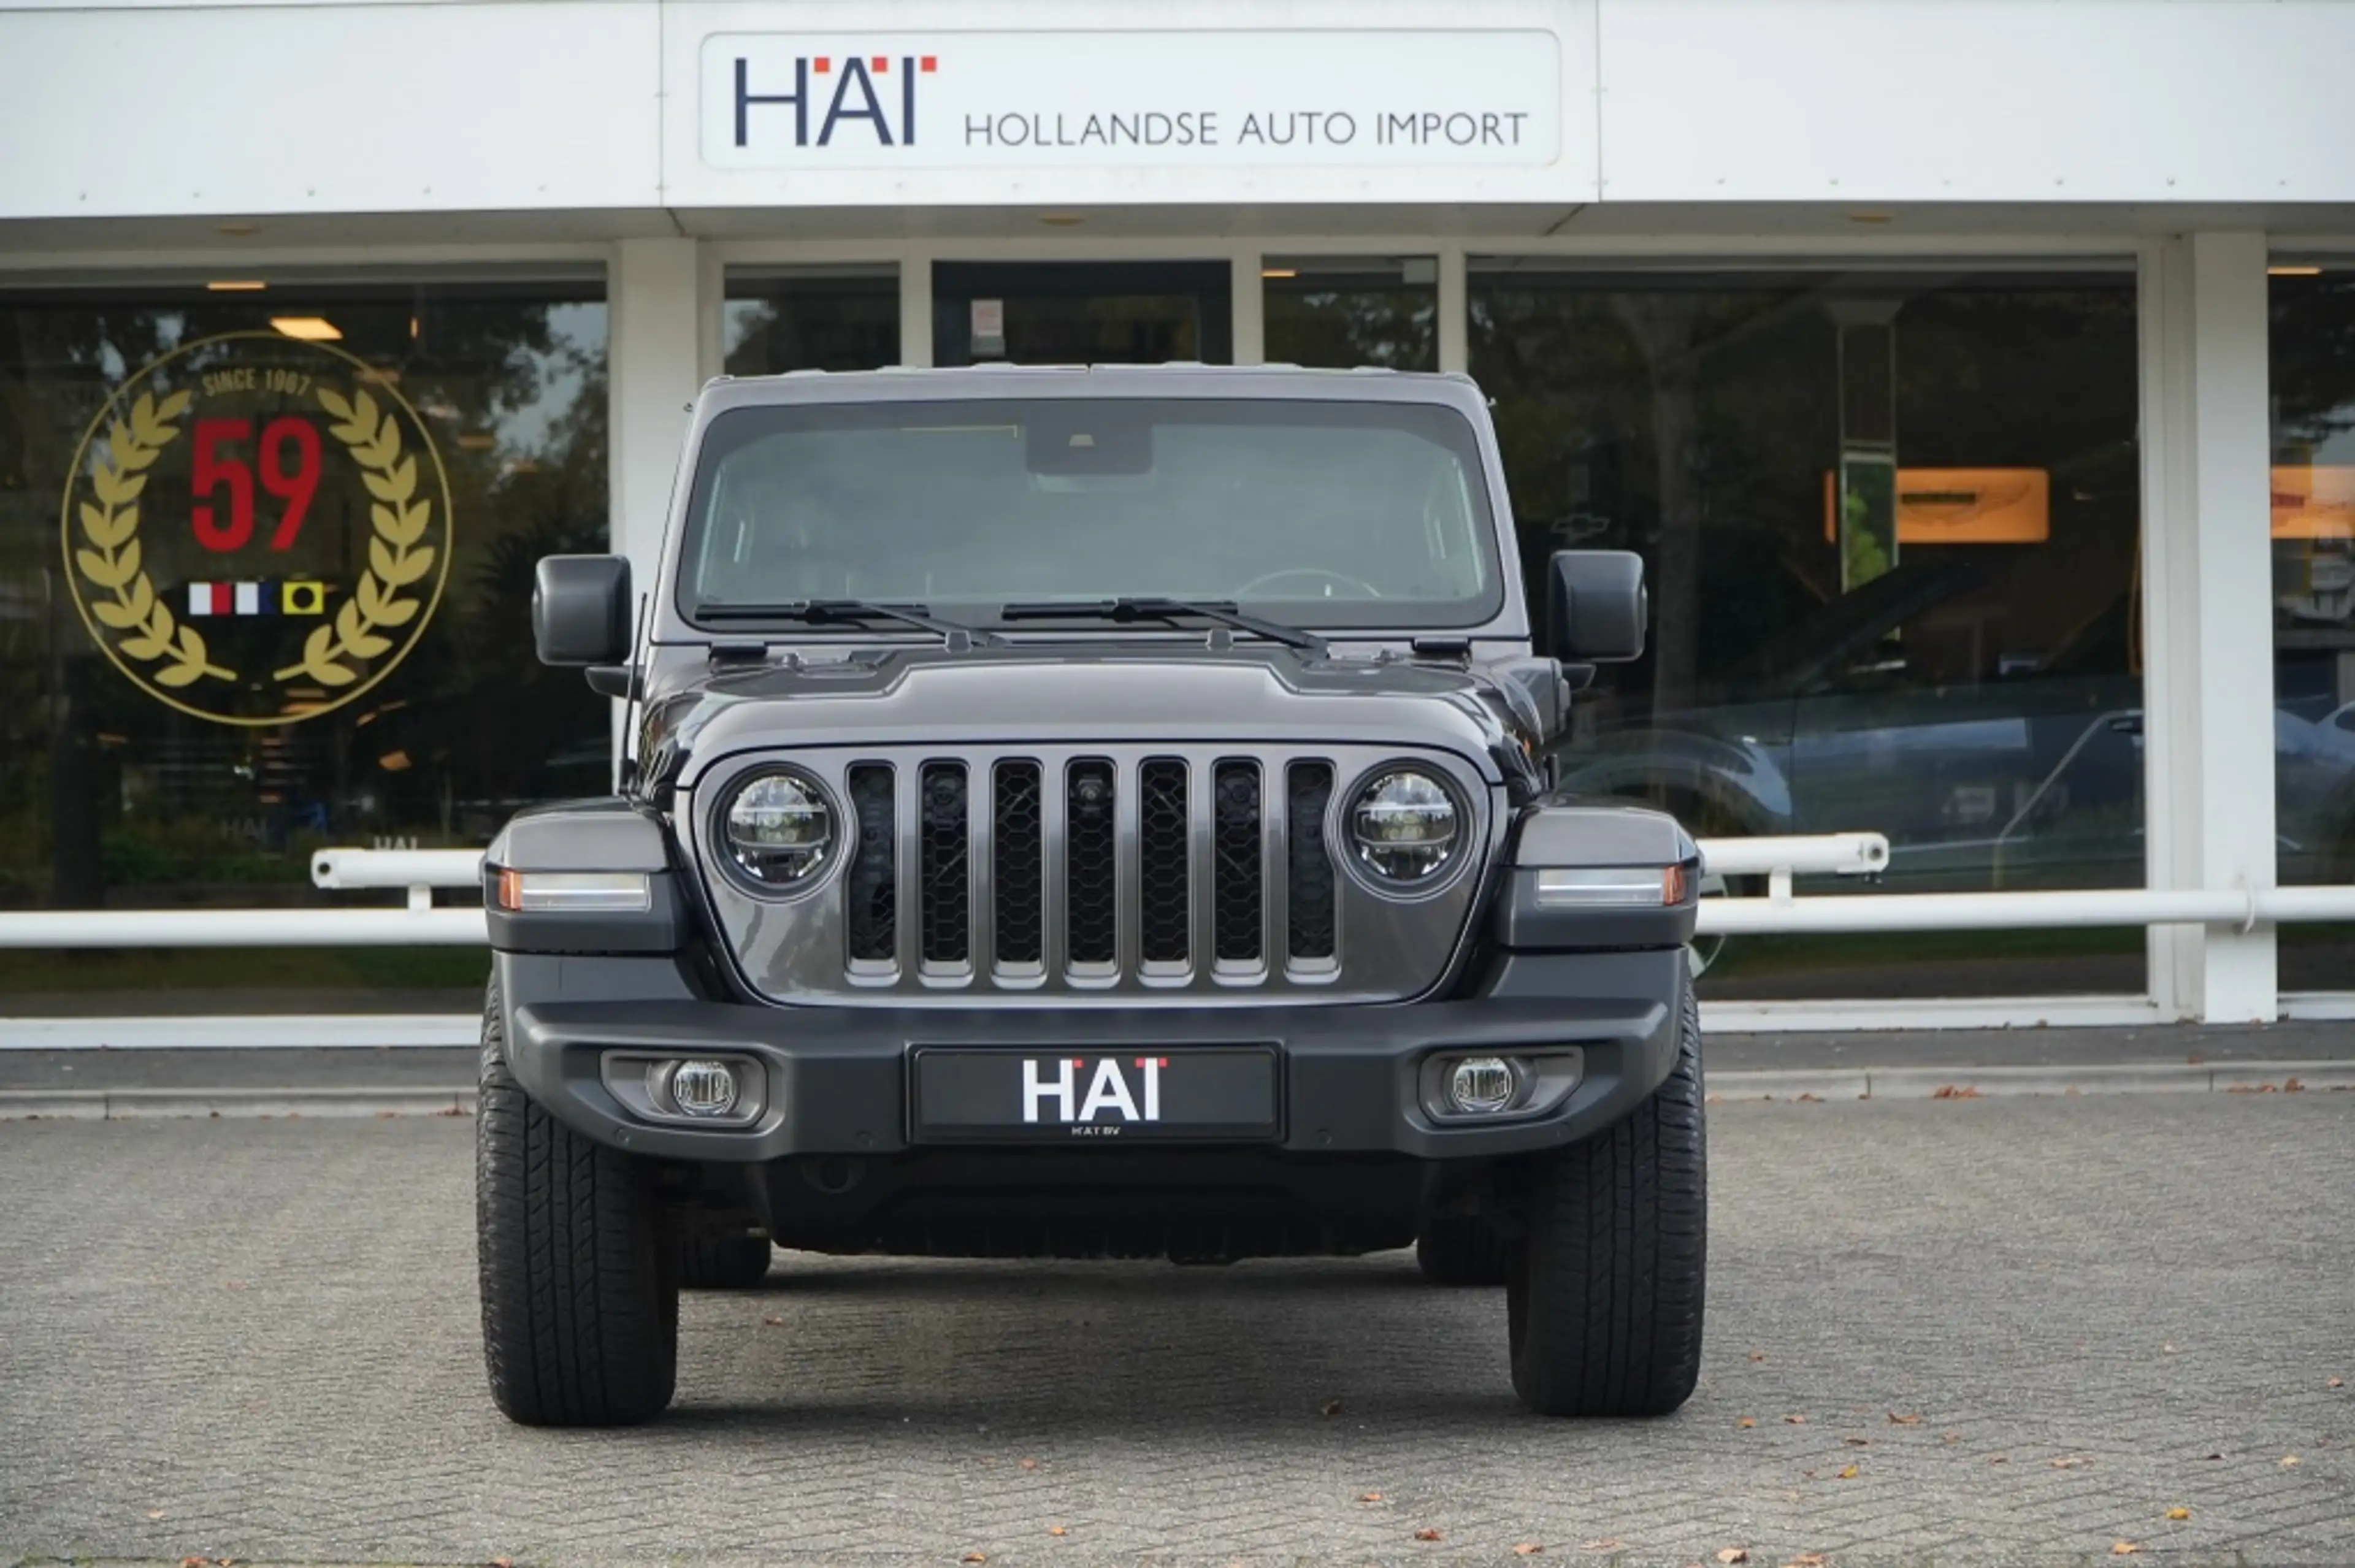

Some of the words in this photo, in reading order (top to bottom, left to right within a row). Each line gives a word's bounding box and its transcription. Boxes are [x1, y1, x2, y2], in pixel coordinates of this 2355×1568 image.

[965, 112, 1217, 146] HOLLANDSE
[1238, 112, 1356, 145] AUTO
[1376, 112, 1529, 145] IMPORT
[202, 369, 256, 397] SINCE
[191, 417, 322, 554] 59
